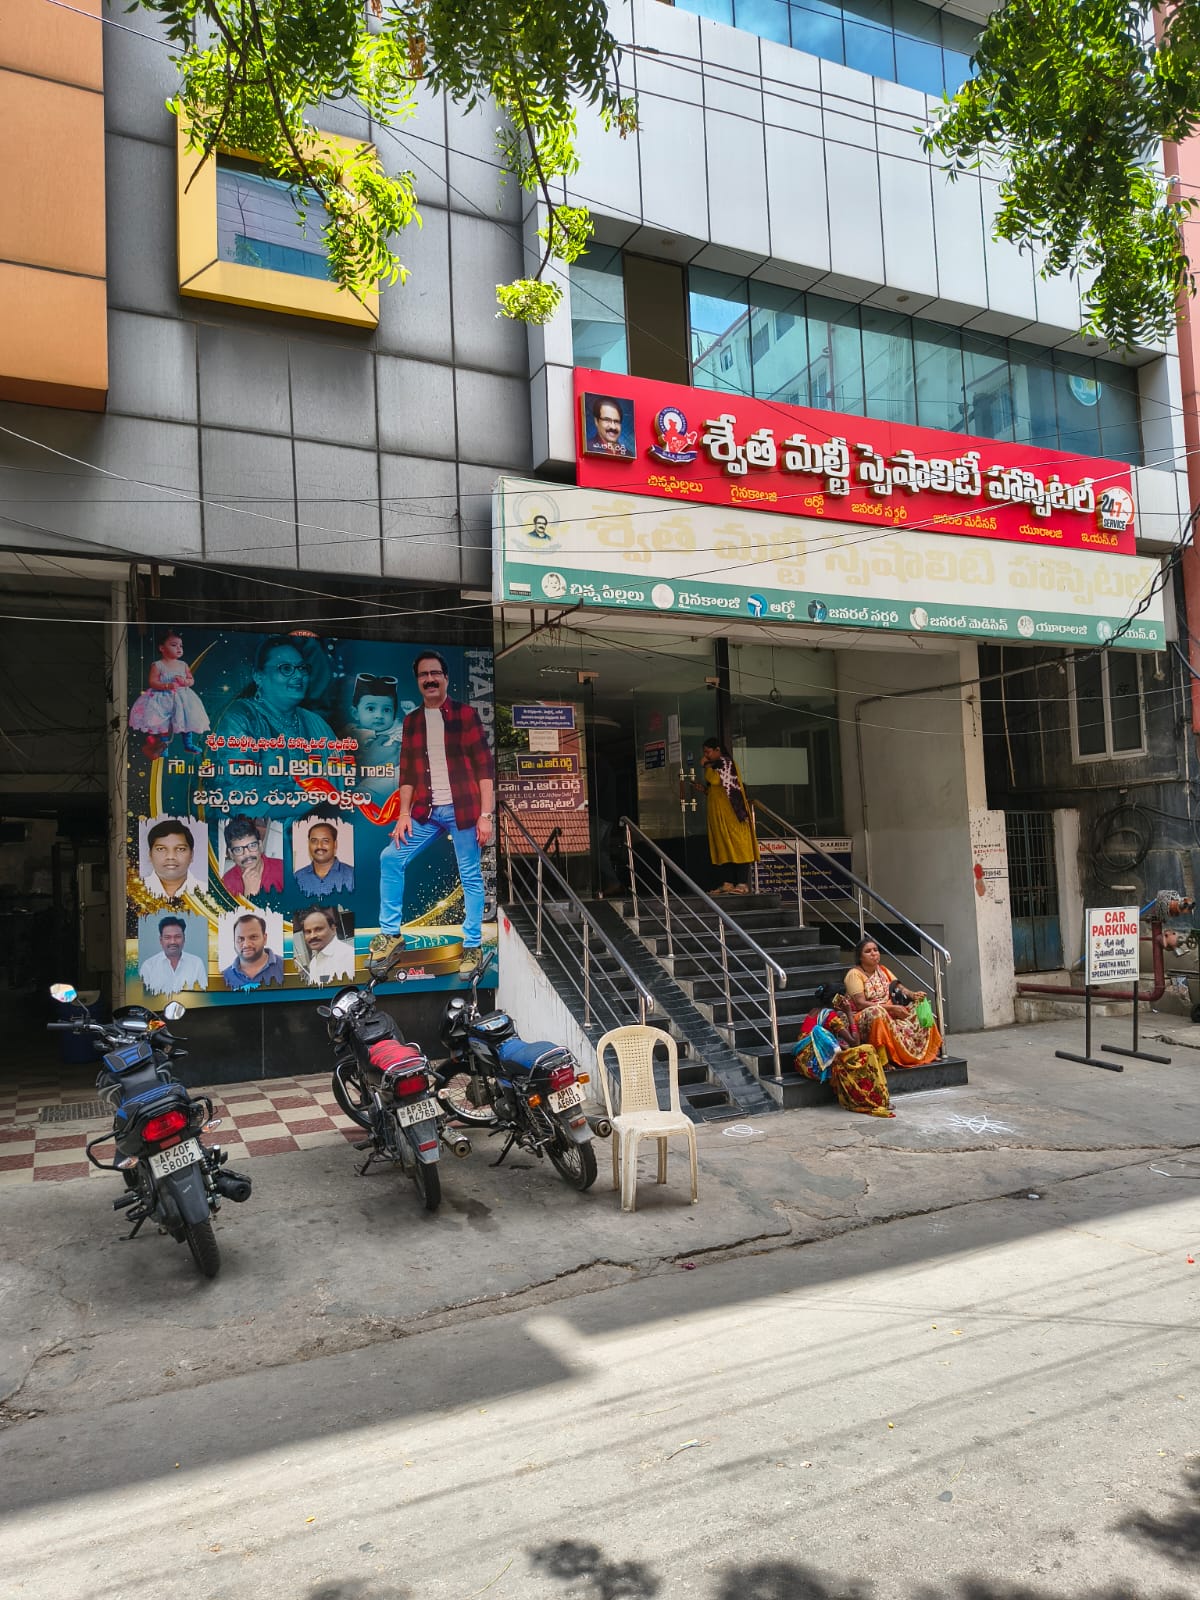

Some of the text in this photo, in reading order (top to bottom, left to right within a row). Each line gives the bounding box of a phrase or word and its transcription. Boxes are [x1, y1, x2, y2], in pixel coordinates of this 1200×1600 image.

[702, 413, 777, 475] శ్వేత
[784, 433, 850, 496] మల్టీ
[856, 442, 982, 496] స్పెషాలిటీ
[987, 465, 1095, 518] హాస్పిటల్
[851, 503, 883, 516] జనరల్
[1103, 518, 1126, 530] SERVICE
[828, 607, 869, 622] జనరల్
[930, 615, 967, 628] జనరల్
[193, 786, 260, 813] జన్మదిన
[1104, 911, 1126, 923] CAR
[1092, 923, 1137, 936] PARKING
[406, 1100, 433, 1115] AP39A
[159, 1142, 191, 1165] AP40F
[162, 1152, 196, 1174] S8002
